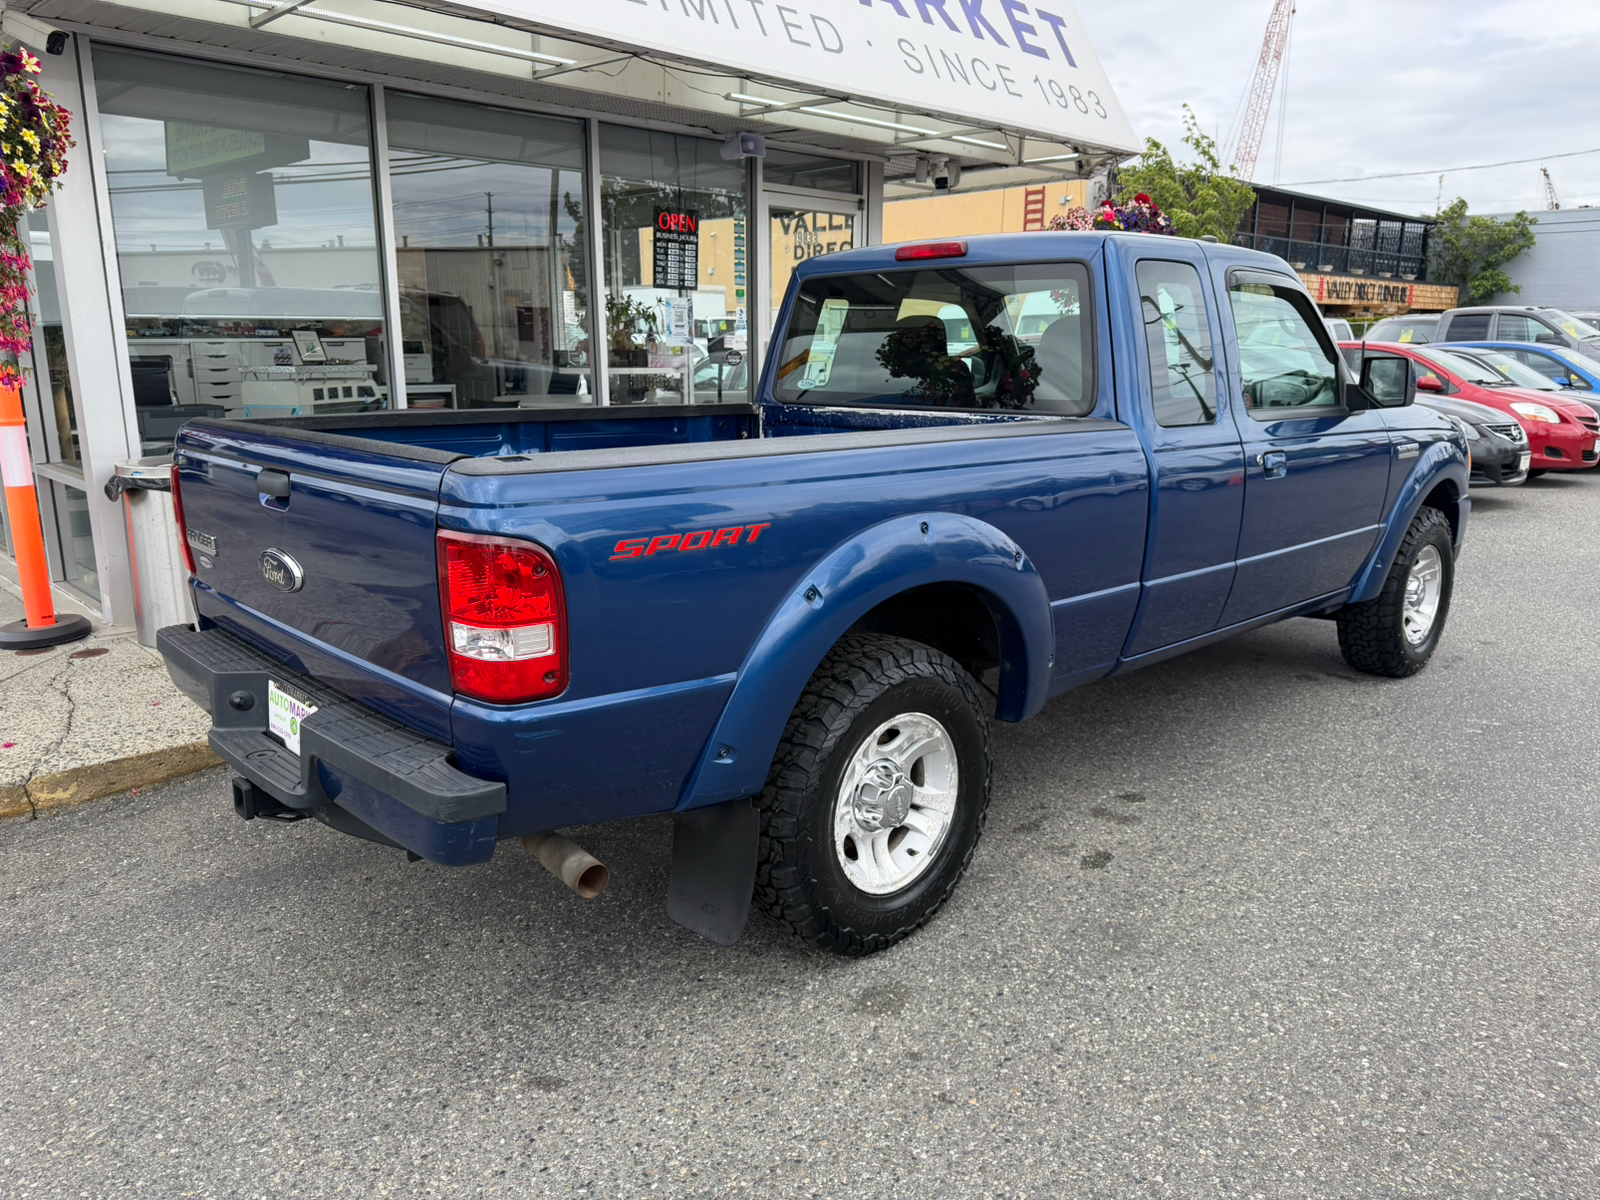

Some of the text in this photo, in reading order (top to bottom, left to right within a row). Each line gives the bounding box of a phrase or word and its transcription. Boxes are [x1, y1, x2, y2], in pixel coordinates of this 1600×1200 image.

[619, 0, 1108, 120] MITED SINCE 1983
[658, 211, 697, 234] OPEN
[656, 231, 698, 243] BUSINESS HOURS
[1327, 279, 1354, 301] VALLEY
[608, 522, 772, 562] SPORT
[262, 556, 286, 585] Ford
